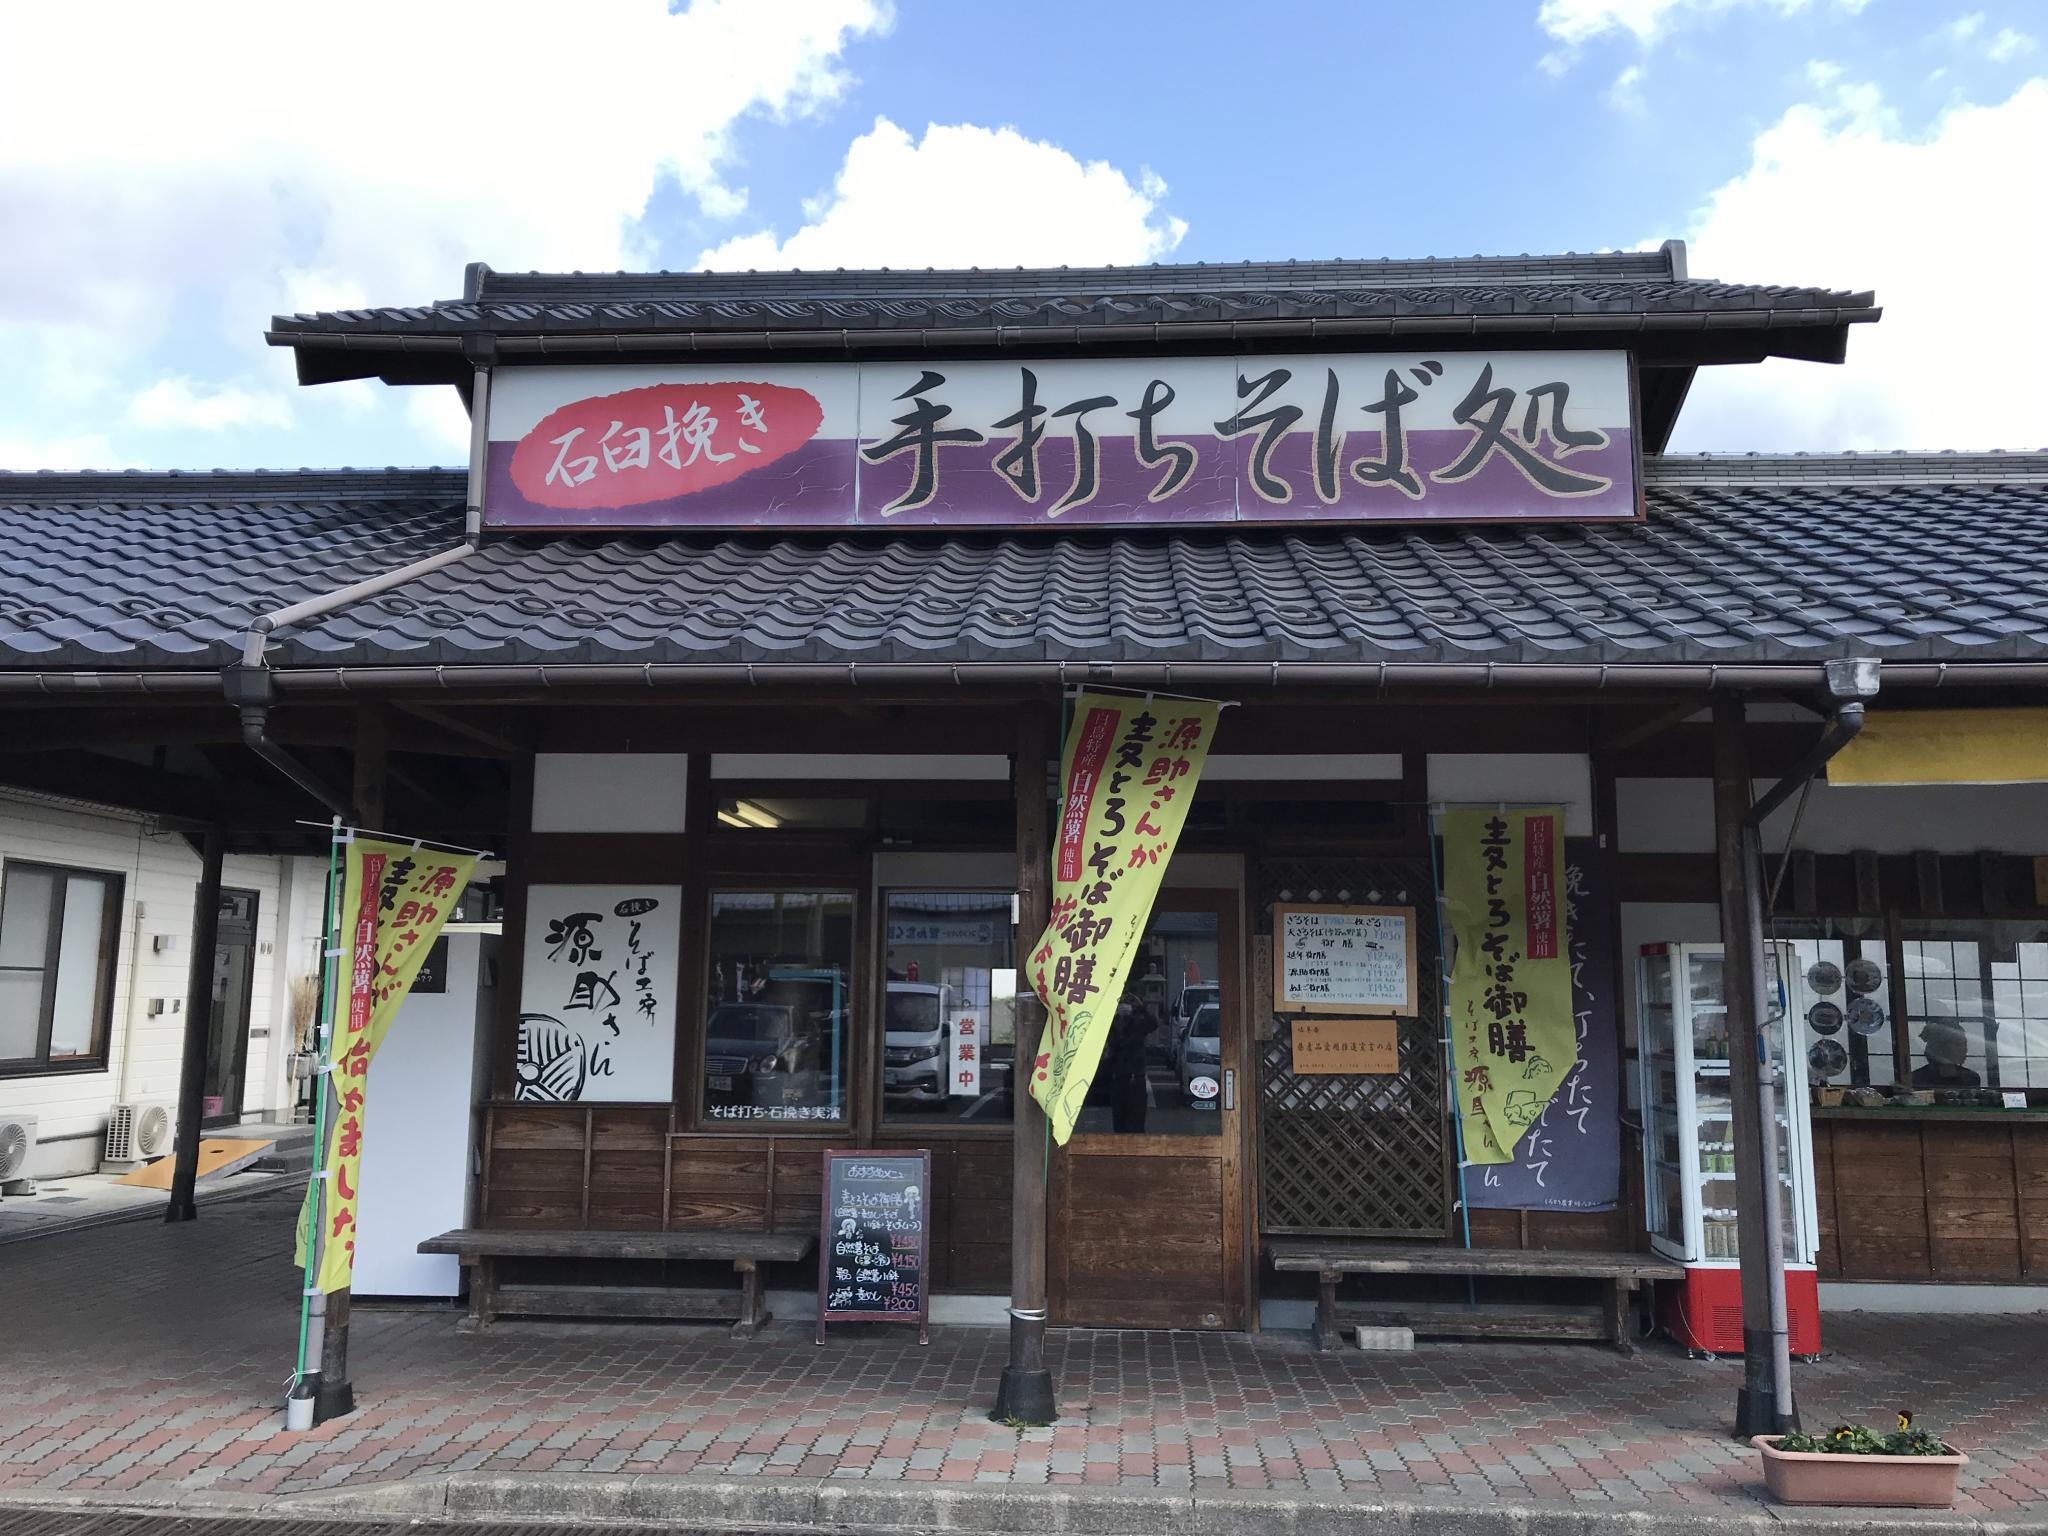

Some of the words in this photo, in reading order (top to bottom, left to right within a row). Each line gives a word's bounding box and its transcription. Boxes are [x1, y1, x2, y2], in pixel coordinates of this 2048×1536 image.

[545, 394, 767, 487] 石臼挽き
[861, 360, 1611, 517] 手打ちそば処
[1054, 711, 1157, 1004] 麦とろそば御膳
[1128, 717, 1202, 869] 源助さんが
[544, 913, 621, 1076] 源助さん
[1480, 816, 1536, 1063] 麦とろそば御膳
[958, 1018, 976, 1088] 営業中
